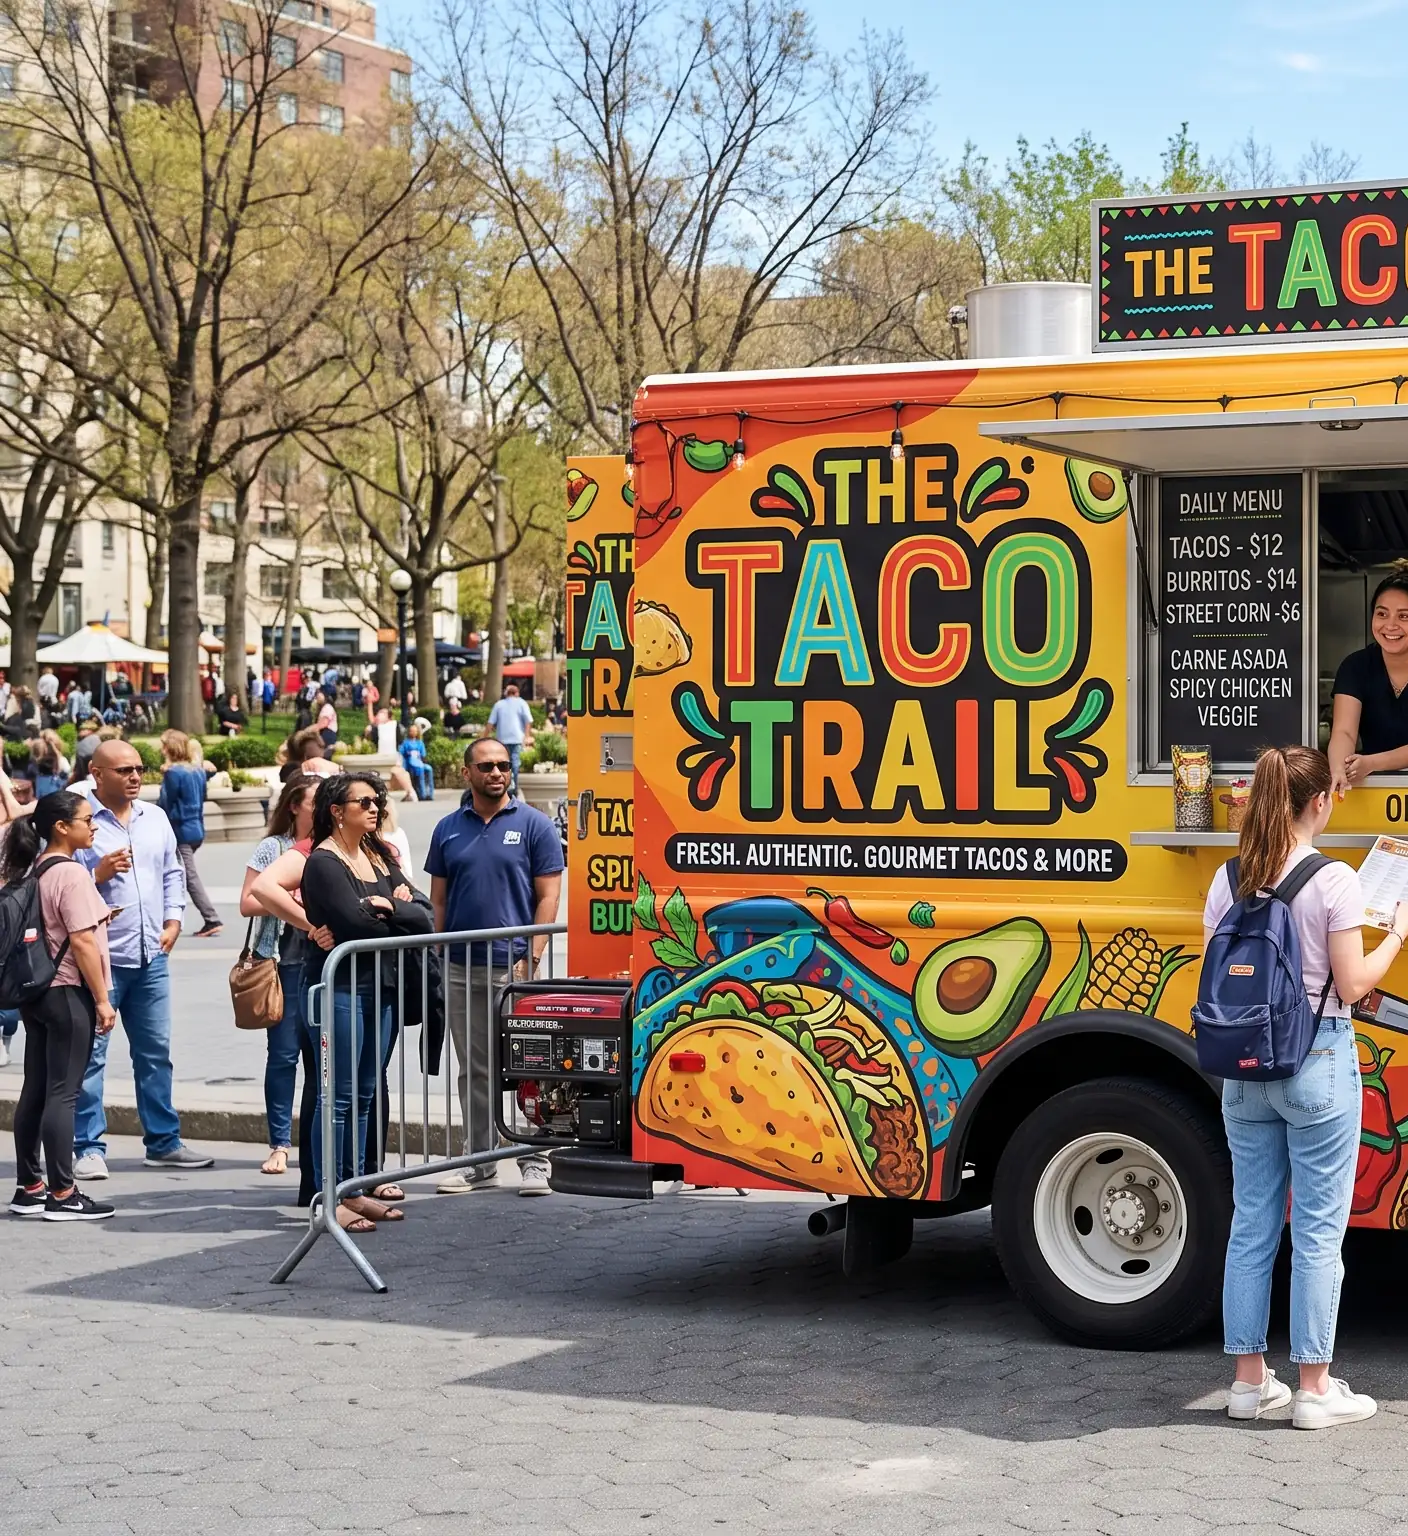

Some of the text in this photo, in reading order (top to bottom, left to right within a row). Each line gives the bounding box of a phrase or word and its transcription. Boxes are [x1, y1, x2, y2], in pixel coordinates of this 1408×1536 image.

[1124, 246, 1213, 298] THE
[824, 455, 948, 525] THE
[1180, 489, 1283, 514] DAILY MENU
[599, 539, 634, 573] TH
[1170, 535, 1230, 559] TACOS
[1250, 533, 1283, 559] $12
[1167, 569, 1251, 592] BURRITOS
[1267, 567, 1297, 592] $14
[697, 532, 1080, 687] TACO
[1166, 603, 1224, 624] STREET
[1227, 602, 1270, 623] CORN
[1171, 648, 1288, 670] CARNE ASADA
[1169, 677, 1292, 699] SPICY CHICKEN
[1197, 705, 1258, 727] VEGGIE
[730, 699, 1051, 811] TRAIL
[676, 842, 1113, 873] FRESH. AUTHENTIC. GOURMET TACOS & MORE
[590, 857, 634, 888] SPI
